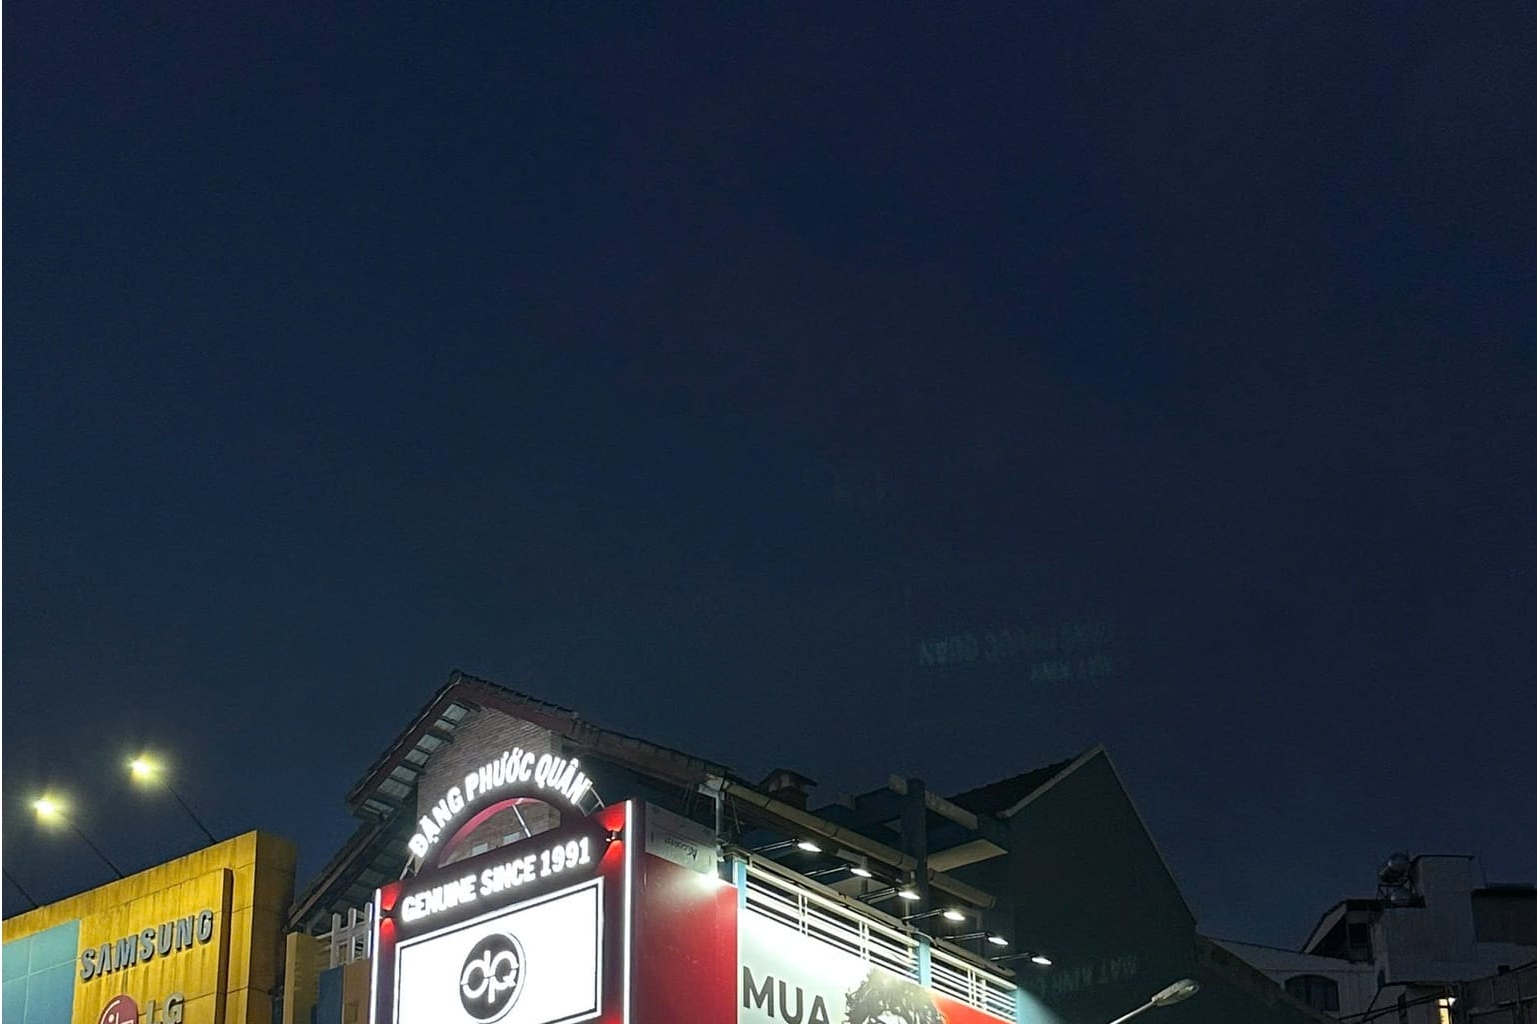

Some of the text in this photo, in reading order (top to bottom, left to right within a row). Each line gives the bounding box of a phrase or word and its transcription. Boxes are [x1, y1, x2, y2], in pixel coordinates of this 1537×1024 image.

[409, 747, 593, 858] ĐẶNG PHƯỚC QUÂN
[401, 837, 591, 923] GENUINE SINCE 1991
[80, 909, 213, 981] SAMSUNG
